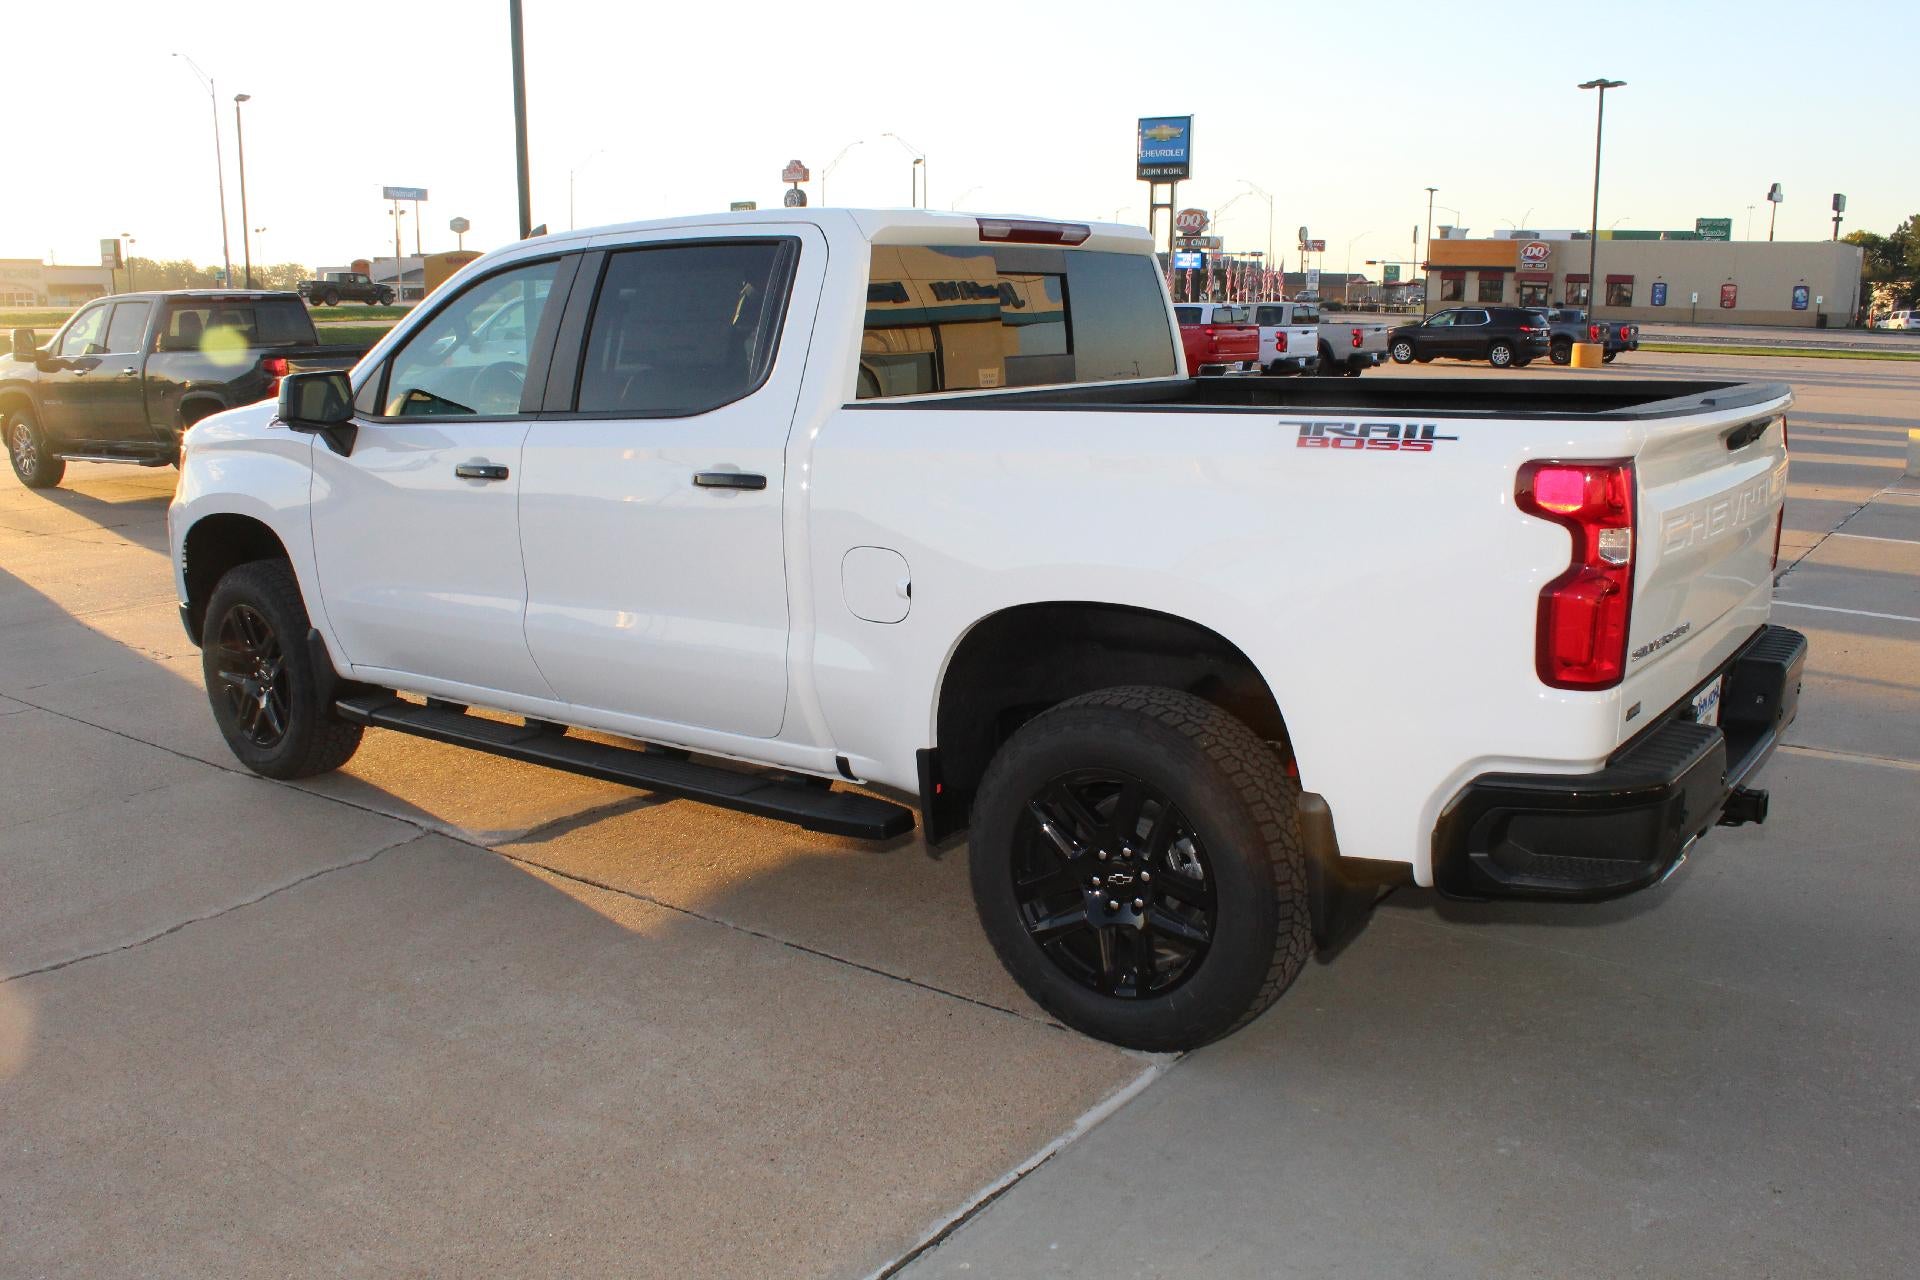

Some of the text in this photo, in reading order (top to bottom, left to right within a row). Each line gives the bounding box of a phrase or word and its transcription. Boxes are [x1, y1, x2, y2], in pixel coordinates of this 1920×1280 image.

[1141, 149, 1184, 157] CHEVROLET
[388, 189, 417, 198] Walmart
[1178, 214, 1201, 227] DQ
[1190, 238, 1208, 246] Chill
[1526, 246, 1545, 258] DQ
[1279, 421, 1458, 441] TRAIL
[1296, 436, 1433, 452] BOSS
